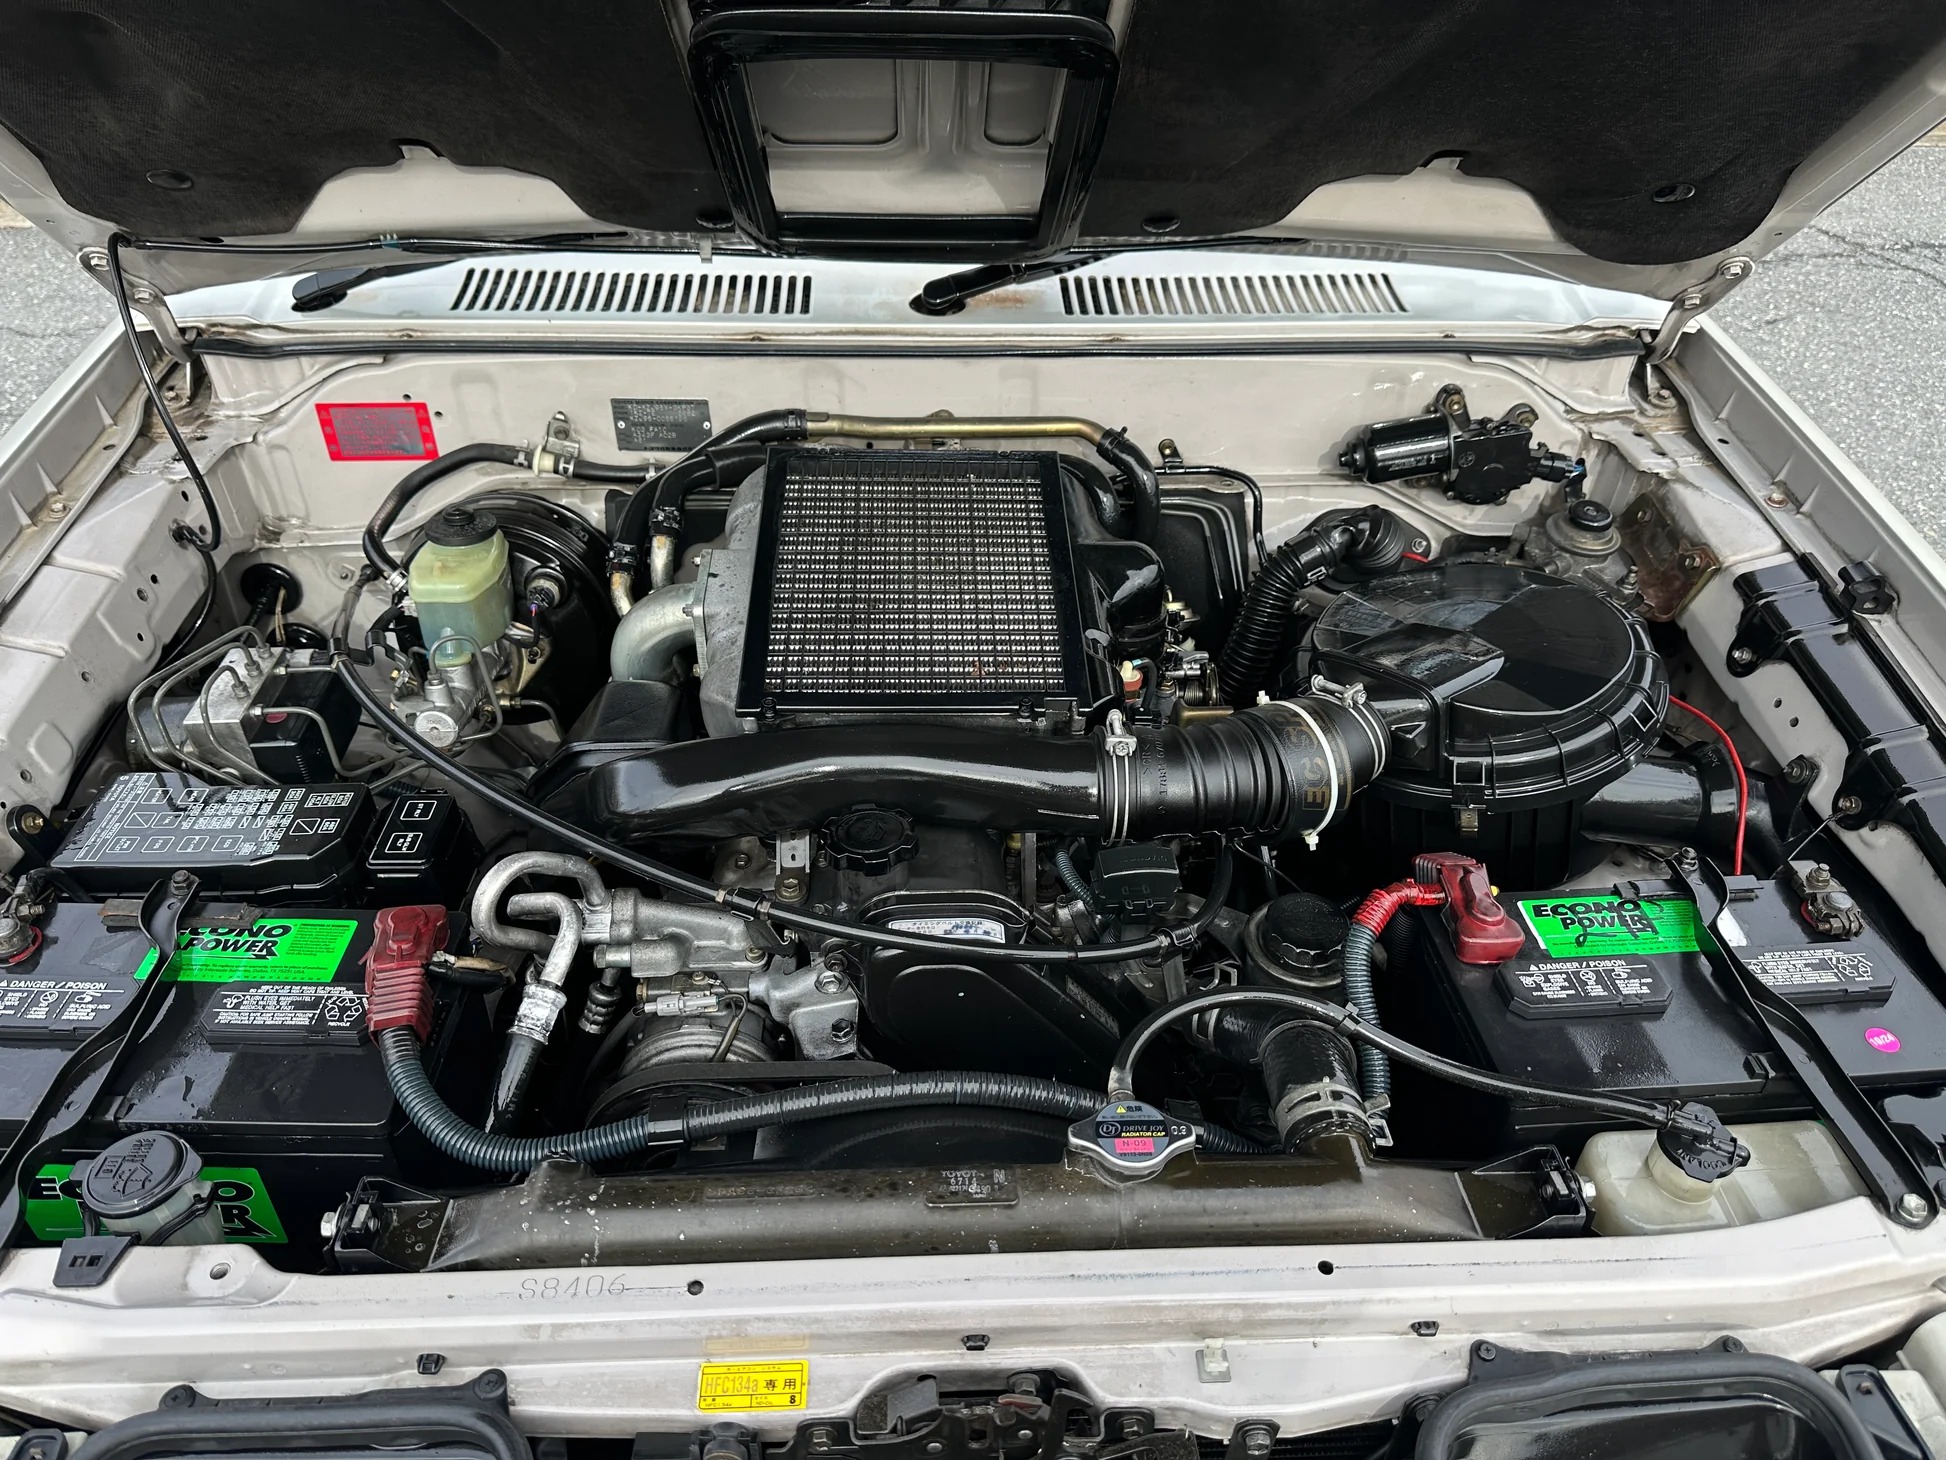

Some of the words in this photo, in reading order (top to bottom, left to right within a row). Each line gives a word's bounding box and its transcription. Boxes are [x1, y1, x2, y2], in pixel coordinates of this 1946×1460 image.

[1531, 900, 1642, 918] ECONO
[1560, 913, 1652, 932] POWER
[184, 938, 278, 959] POWER
[1538, 962, 1580, 970] DANGER
[1588, 960, 1627, 968] POISON
[10, 980, 56, 989] DANGER
[65, 982, 108, 990] POISON
[518, 1274, 626, 1300] S8406
[704, 1376, 759, 1394] HFC134a
[763, 1378, 797, 1392] 専用
[789, 1394, 797, 1404] 8
